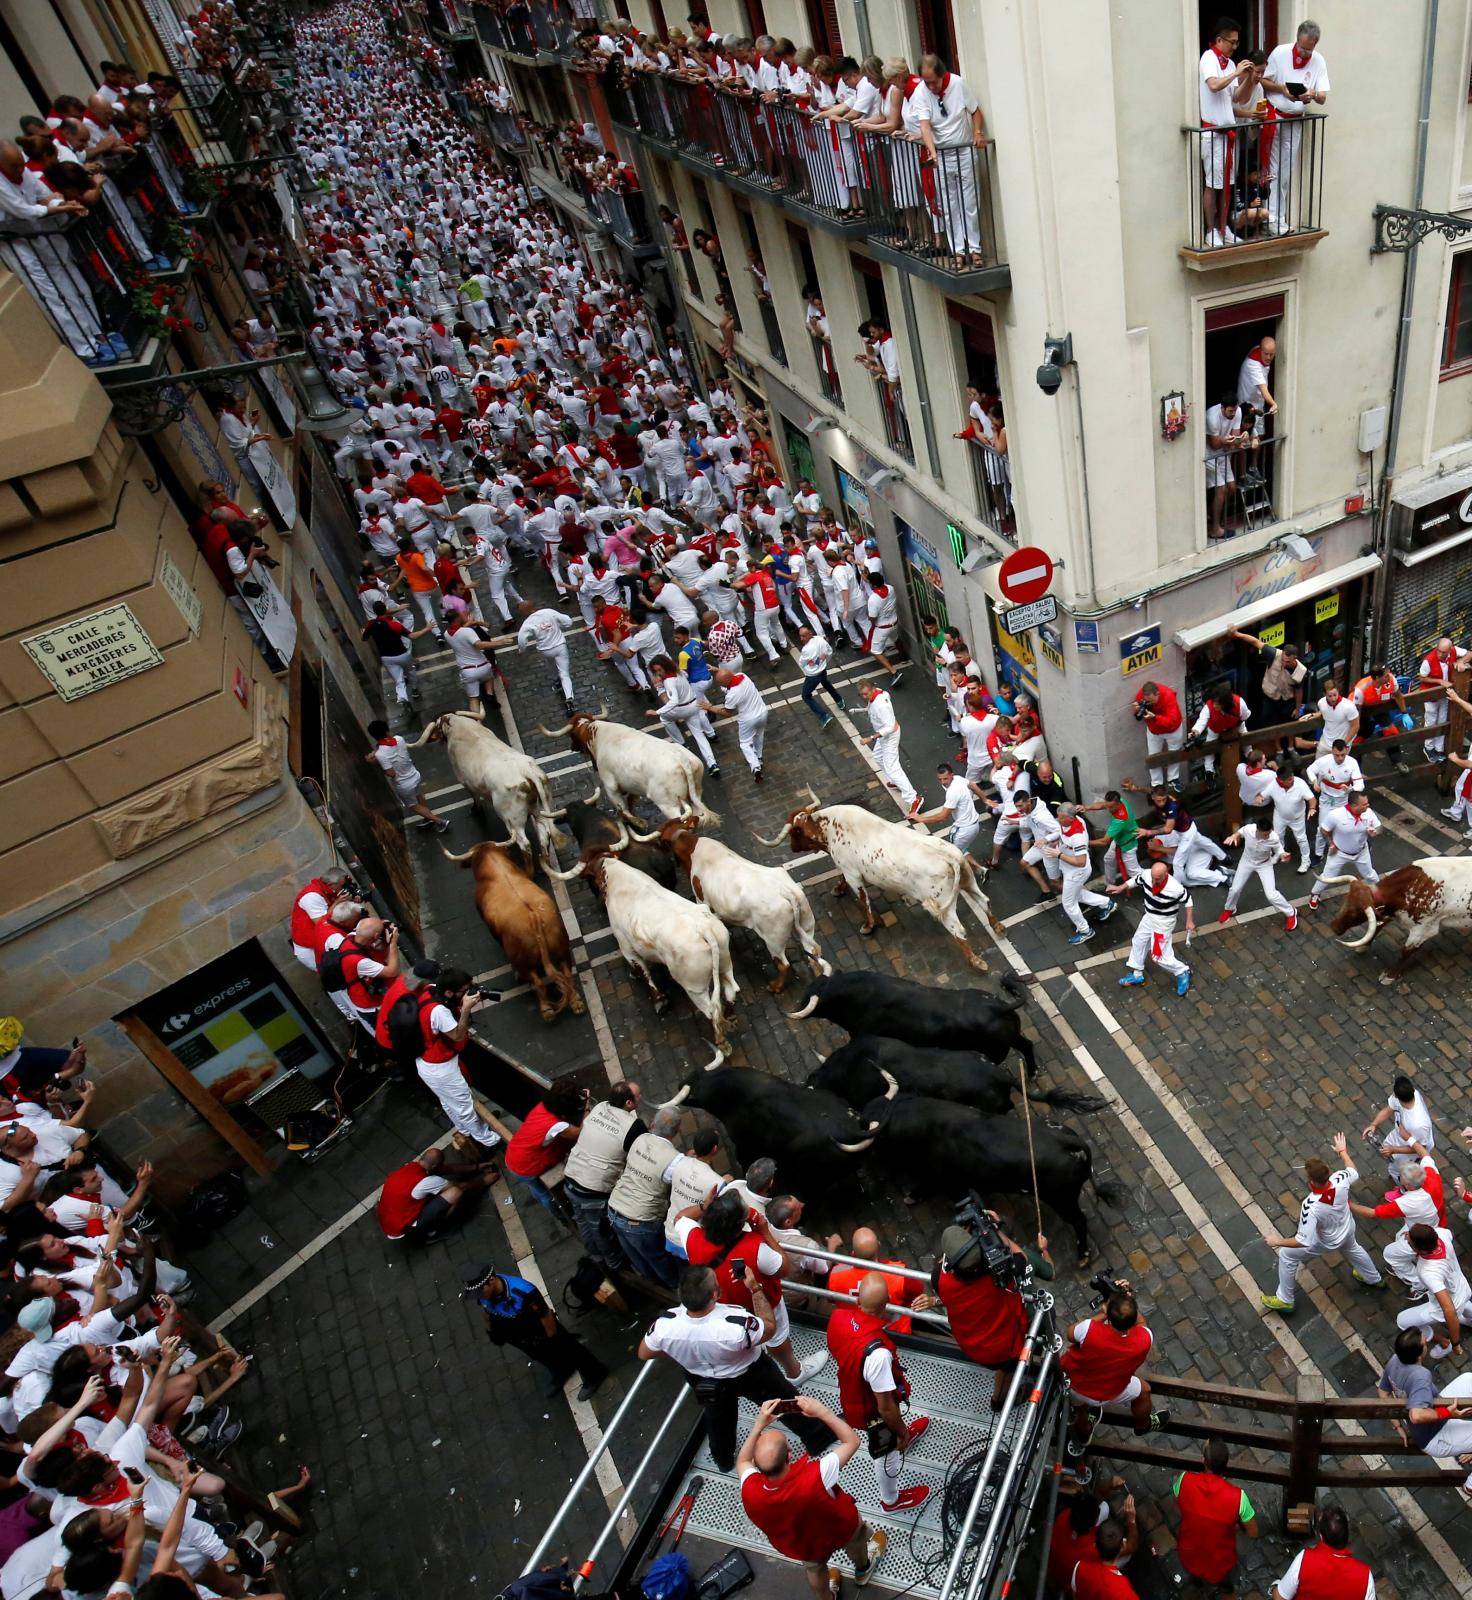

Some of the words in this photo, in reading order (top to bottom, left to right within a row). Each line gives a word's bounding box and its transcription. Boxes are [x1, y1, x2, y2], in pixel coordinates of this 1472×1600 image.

[434, 370, 449, 382] 20
[705, 543, 712, 554] 7
[1316, 601, 1337, 614] hielo
[67, 626, 100, 644] CALLE
[56, 631, 126, 663] MERCADERES
[1042, 642, 1061, 668] ATM
[65, 643, 137, 677] MERCADERES
[1127, 647, 1158, 671] ATM
[89, 662, 125, 680] KALEA
[194, 977, 251, 1015] express
[590, 1116, 619, 1135] CARPINTERO
